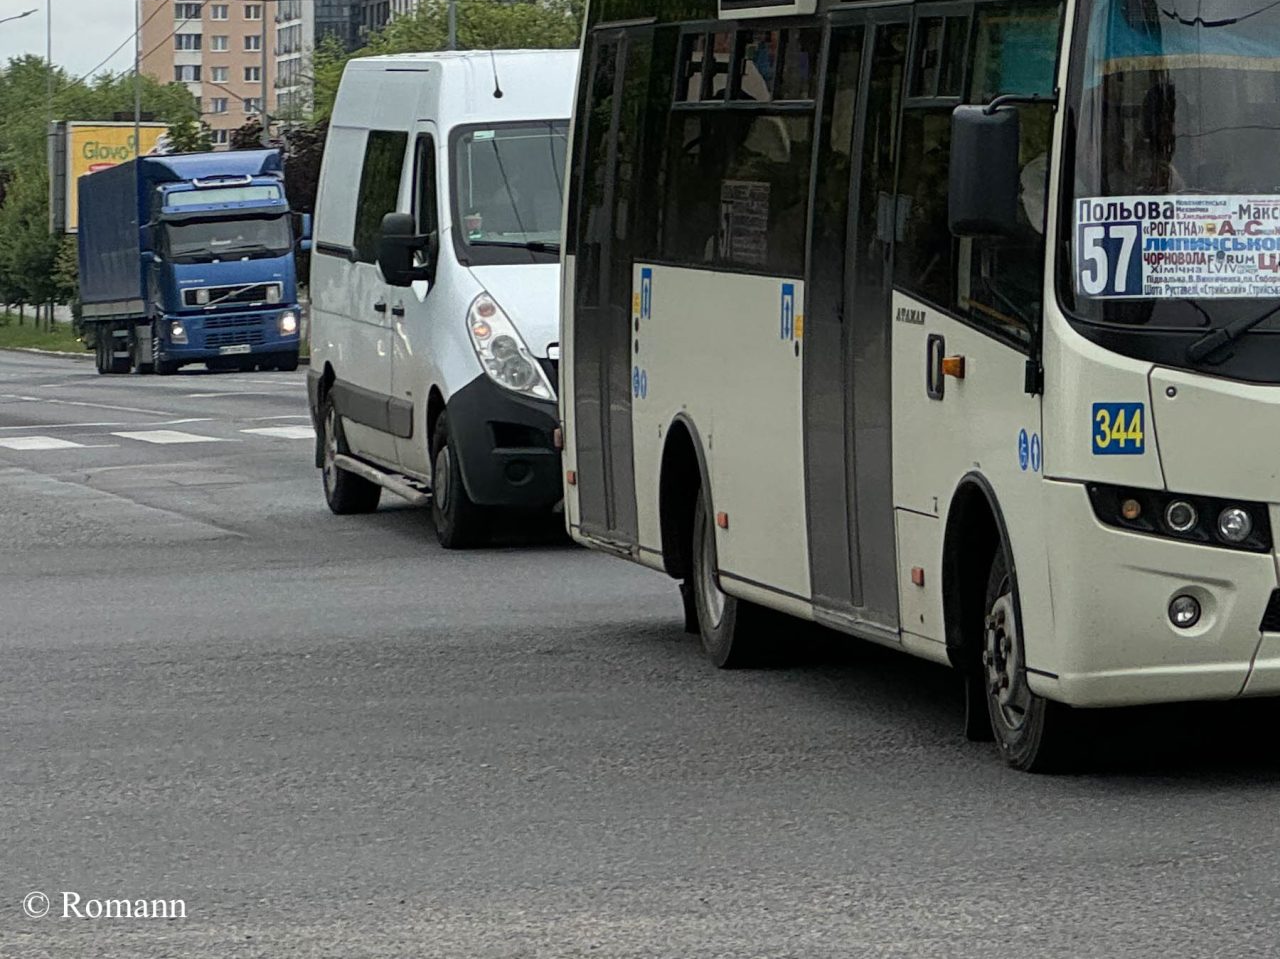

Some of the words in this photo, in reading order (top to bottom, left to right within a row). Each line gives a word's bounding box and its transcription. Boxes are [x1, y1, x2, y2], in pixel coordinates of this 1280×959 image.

[82, 141, 129, 160] Glovo
[1080, 200, 1175, 222] Польова
[1081, 224, 1138, 295] 57
[1143, 252, 1207, 266] ЧОРНОВОЛА
[1095, 408, 1143, 448] 344
